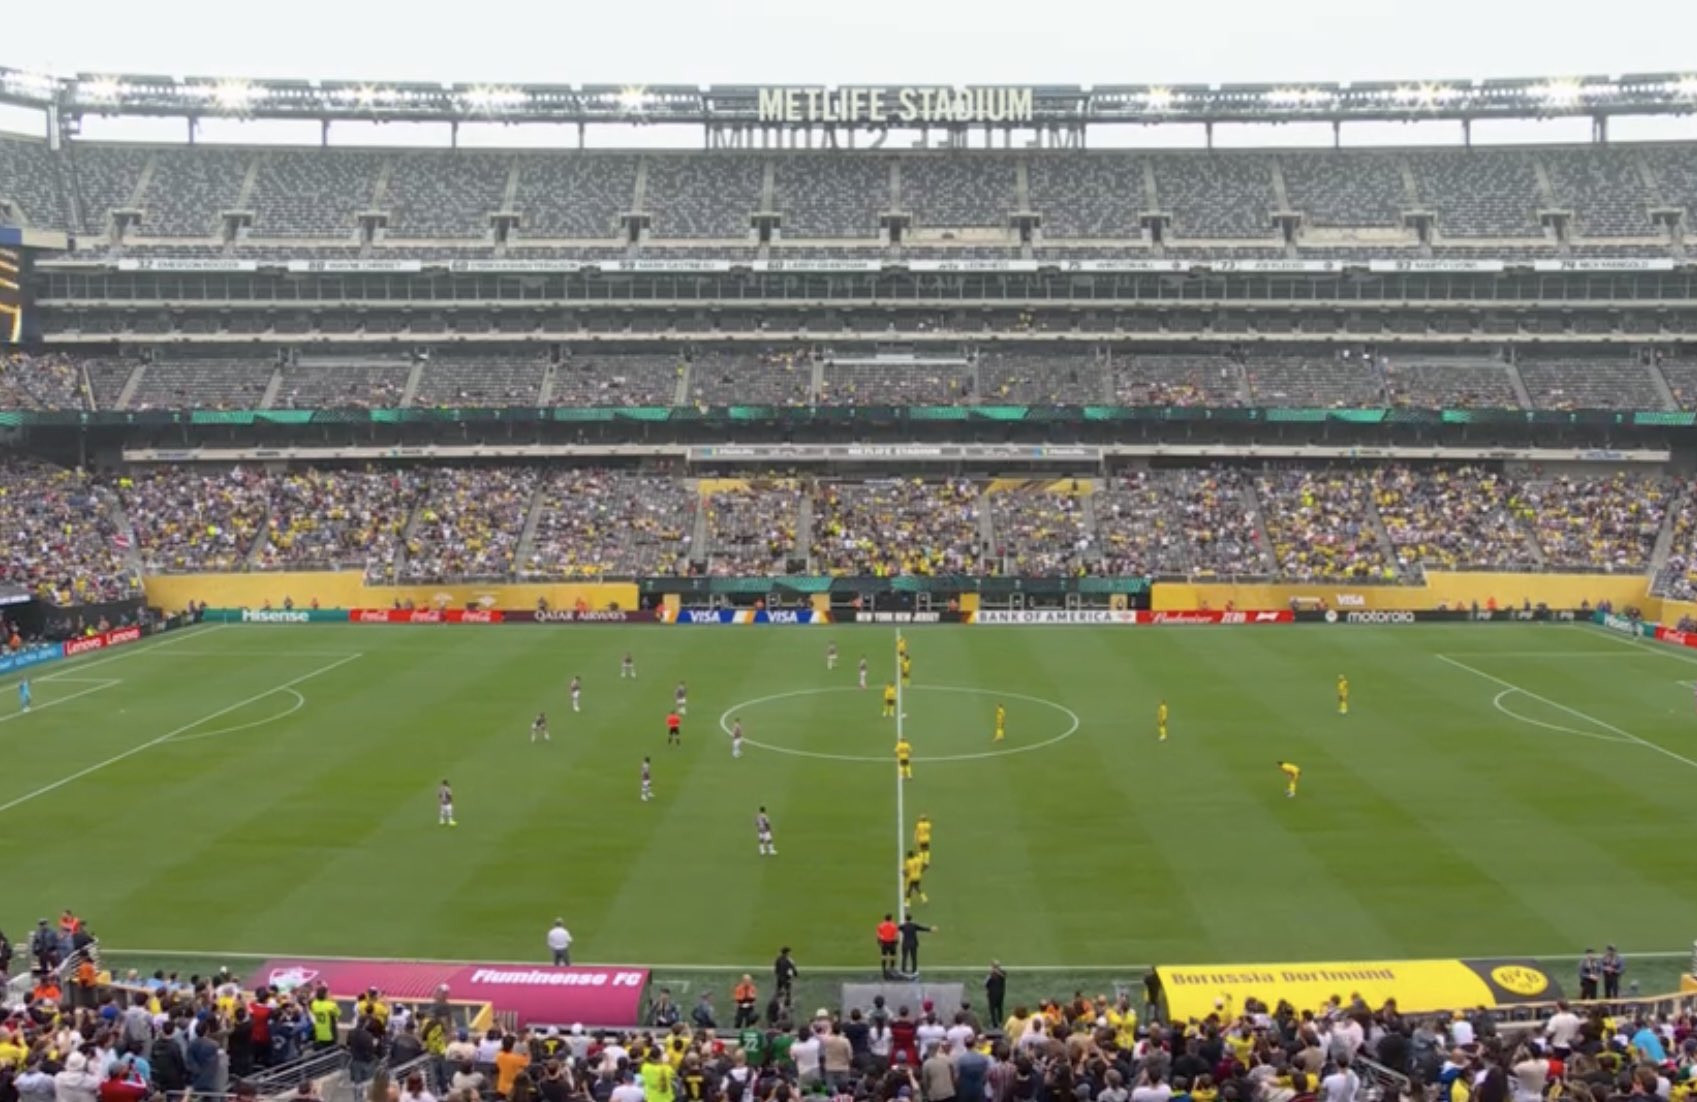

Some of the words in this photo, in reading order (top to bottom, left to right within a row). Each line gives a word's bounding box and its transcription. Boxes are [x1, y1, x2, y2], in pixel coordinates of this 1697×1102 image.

[758, 87, 887, 122] METLIFE
[899, 87, 1033, 122] STADIUM
[1336, 593, 1364, 605] VISA
[242, 608, 309, 622] Hisense
[534, 611, 573, 621] QATAR
[689, 610, 721, 622] VISA
[767, 610, 798, 622] VISA
[979, 611, 1020, 622] BANK
[1023, 611, 1041, 622] OF
[1046, 611, 1112, 622] AMERICA
[1152, 611, 1213, 623] Budweiser
[1347, 610, 1414, 623] motorola
[471, 968, 606, 986] Fluminense
[612, 972, 642, 986] FC
[1171, 970, 1275, 986] Borussia
[1281, 968, 1396, 984] Dortmund
